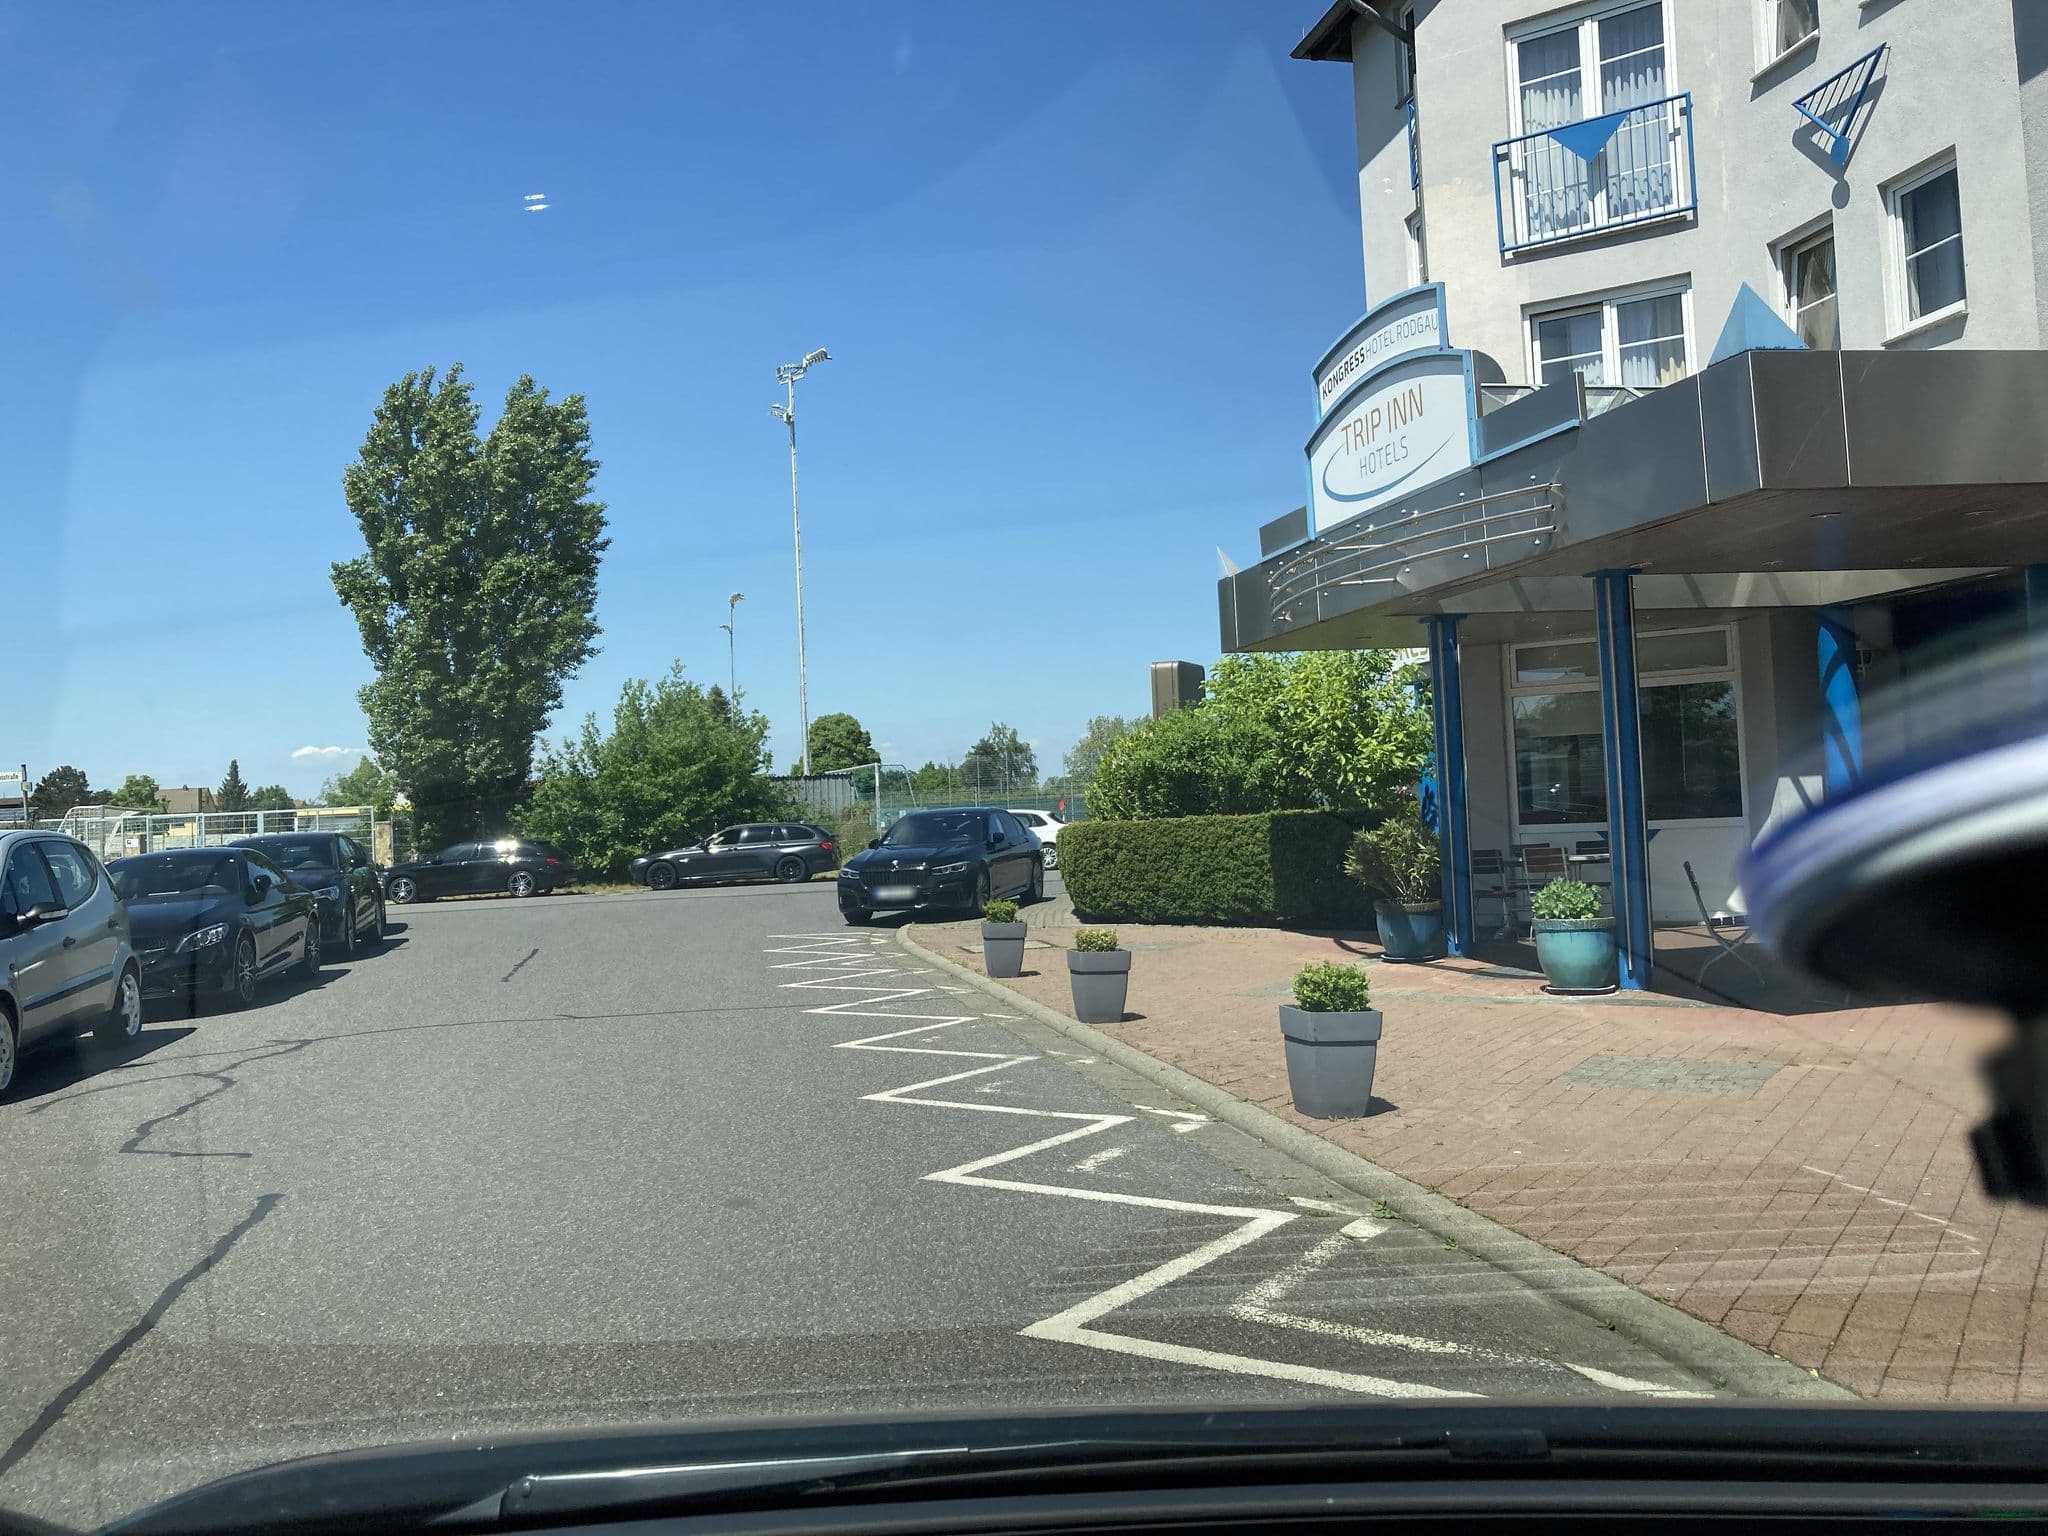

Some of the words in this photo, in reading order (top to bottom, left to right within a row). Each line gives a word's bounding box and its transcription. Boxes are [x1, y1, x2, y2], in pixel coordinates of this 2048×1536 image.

[1396, 313, 1438, 341] RODGAU
[1341, 407, 1381, 456] TRIP
[1387, 383, 1423, 433] INN
[1360, 435, 1409, 479] HOTELS
